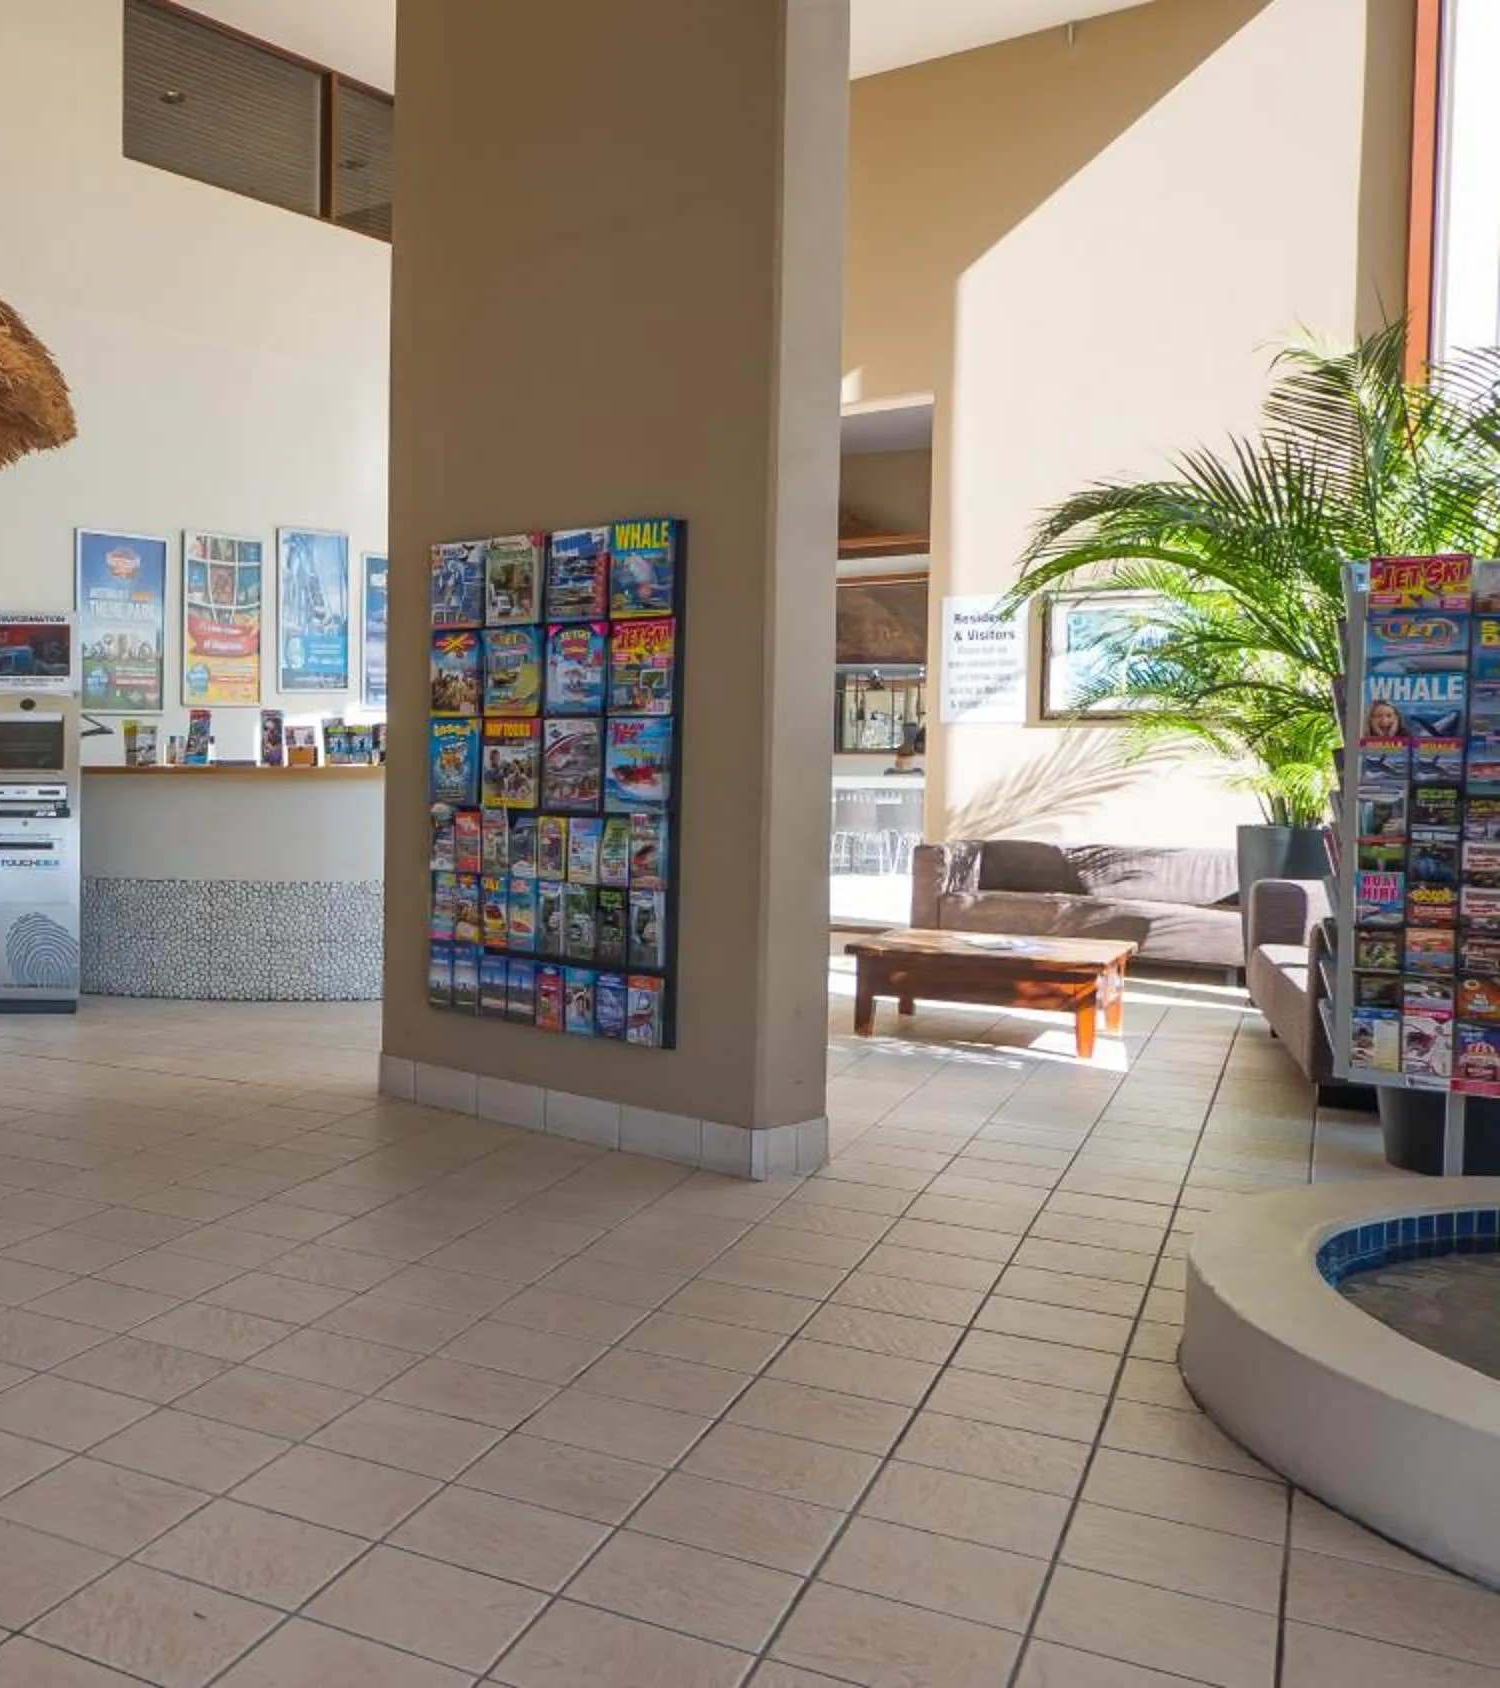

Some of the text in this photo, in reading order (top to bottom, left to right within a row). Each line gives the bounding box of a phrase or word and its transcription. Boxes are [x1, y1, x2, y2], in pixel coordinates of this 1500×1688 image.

[615, 521, 669, 550] WHALE
[1377, 558, 1471, 595] JET SKI
[953, 629, 1017, 642] & Visitors
[1368, 674, 1463, 701] WHALE
[1363, 875, 1398, 887] BOAT
[1362, 887, 1399, 901] HIRE
